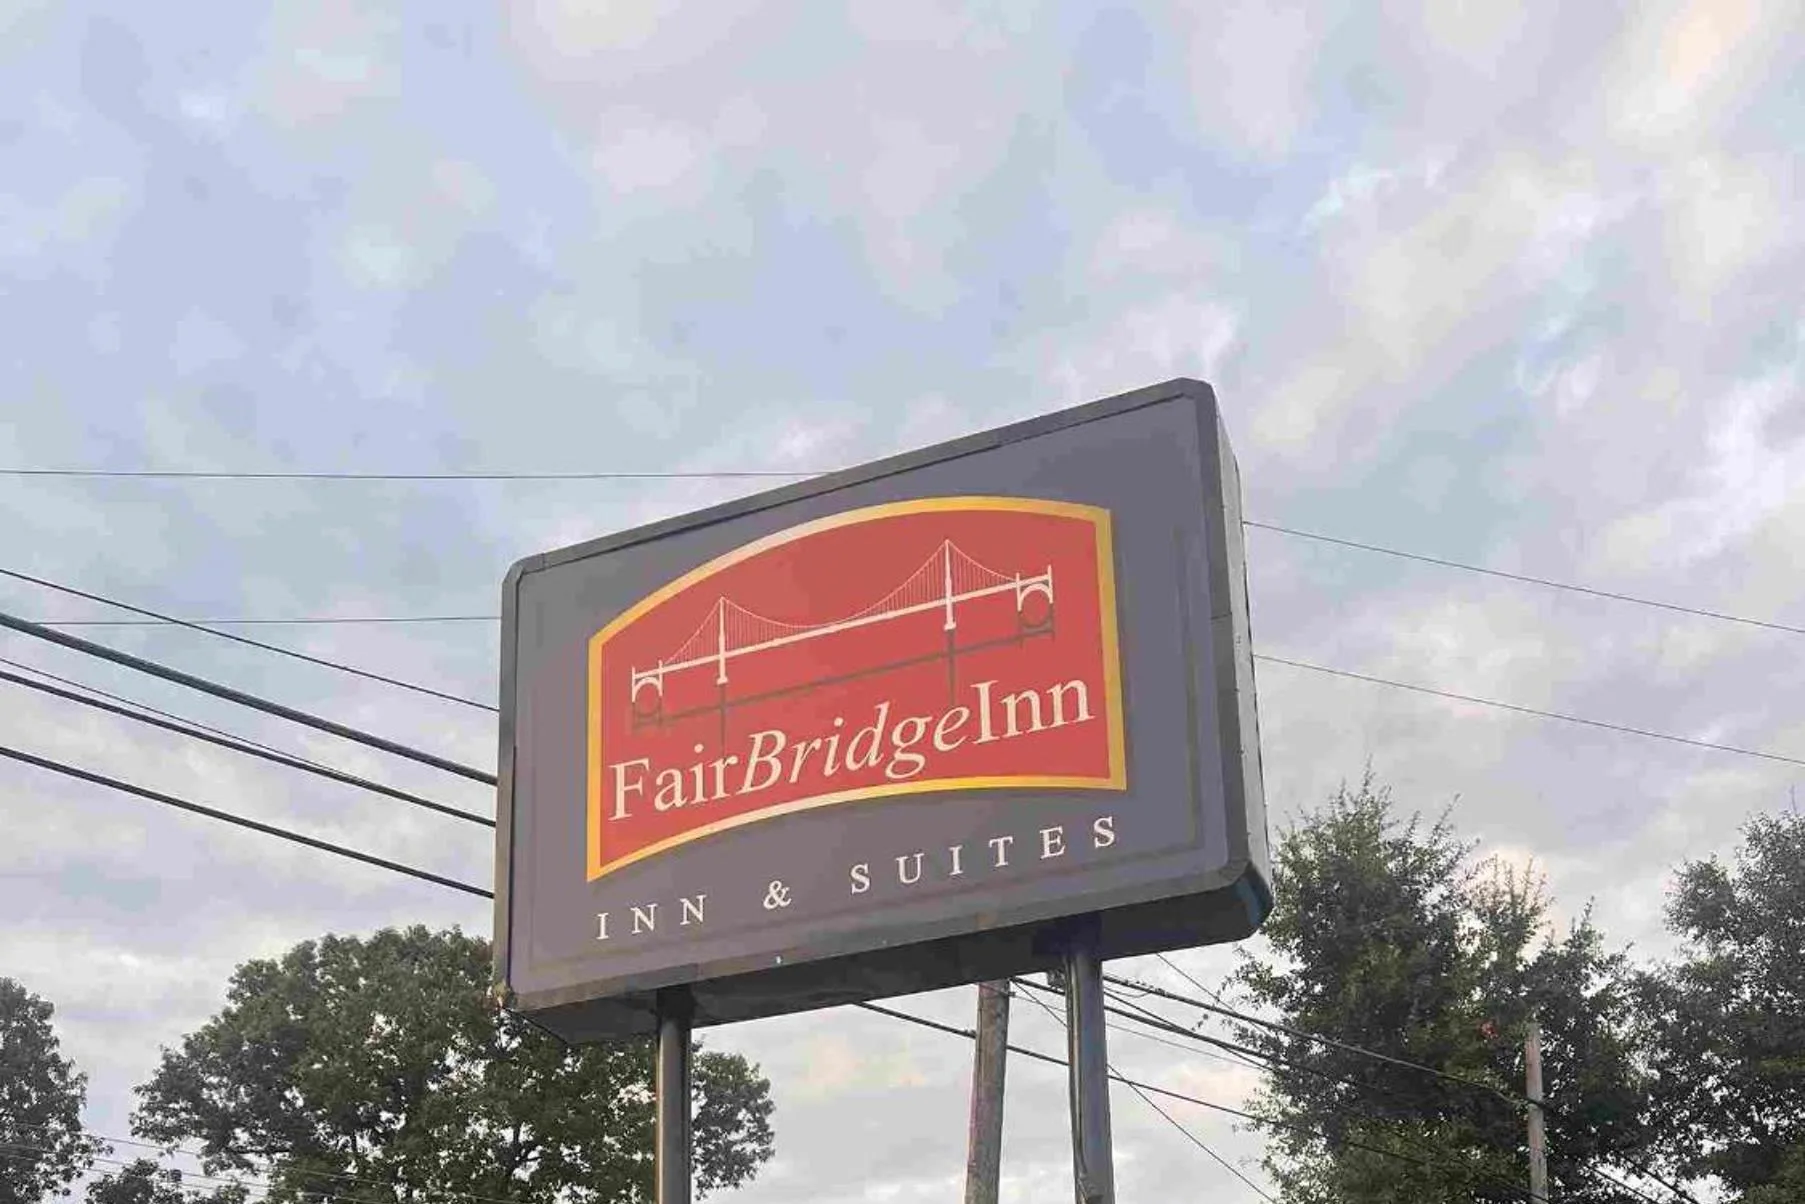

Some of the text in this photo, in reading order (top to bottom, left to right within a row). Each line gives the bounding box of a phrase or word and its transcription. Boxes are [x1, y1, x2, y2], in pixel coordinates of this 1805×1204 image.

[596, 816, 1117, 940] INN & SUITES
